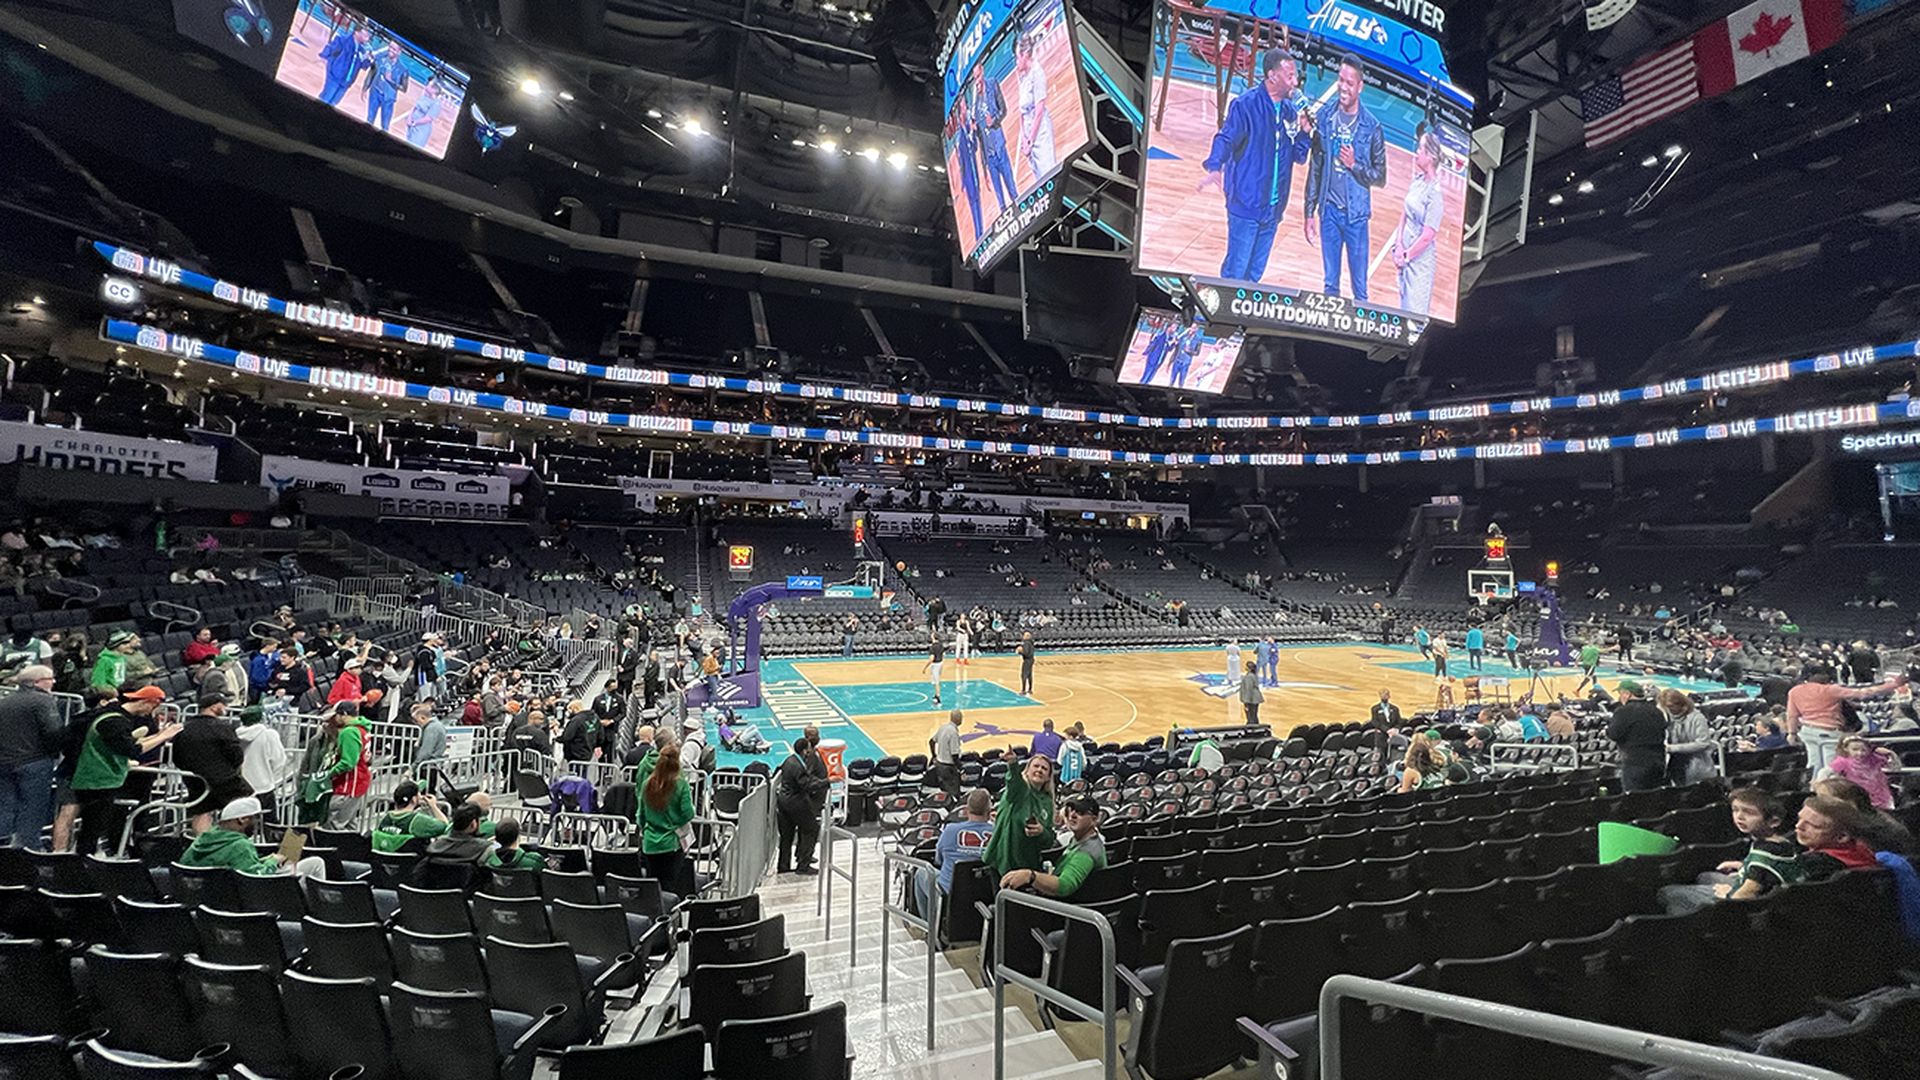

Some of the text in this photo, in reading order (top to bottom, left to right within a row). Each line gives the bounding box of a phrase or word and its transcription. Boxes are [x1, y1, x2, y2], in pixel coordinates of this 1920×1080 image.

[1375, 0, 1445, 32] NTER
[109, 284, 130, 298] CC
[1305, 294, 1345, 313] 42:52
[1230, 299, 1402, 340] COUNTDOWN TO TIP-OFF
[149, 257, 181, 284] LIVE
[243, 287, 269, 310] LIVE
[431, 332, 455, 349] LIVE
[504, 347, 525, 362] LIVE
[568, 360, 587, 374] LIVE
[708, 376, 726, 388] LIVE
[765, 382, 782, 393] LIVE
[1531, 398, 1551, 411] LIVE
[1599, 390, 1620, 404] LIVE
[1665, 382, 1687, 395] LIVE
[1845, 348, 1874, 365] LIVE
[172, 335, 204, 359] LIVE
[264, 357, 290, 378] LIVE
[454, 391, 477, 406] LIVE
[526, 402, 548, 416] LIVE
[589, 411, 609, 424] LIVE
[732, 423, 750, 434] LIVE
[789, 427, 806, 438] LIVE
[1588, 437, 1609, 450] LIVE
[1657, 428, 1679, 443] LIVE
[1731, 419, 1756, 435] LIVE
[54, 440, 160, 460] CHARLOTTE
[827, 753, 838, 764] G
